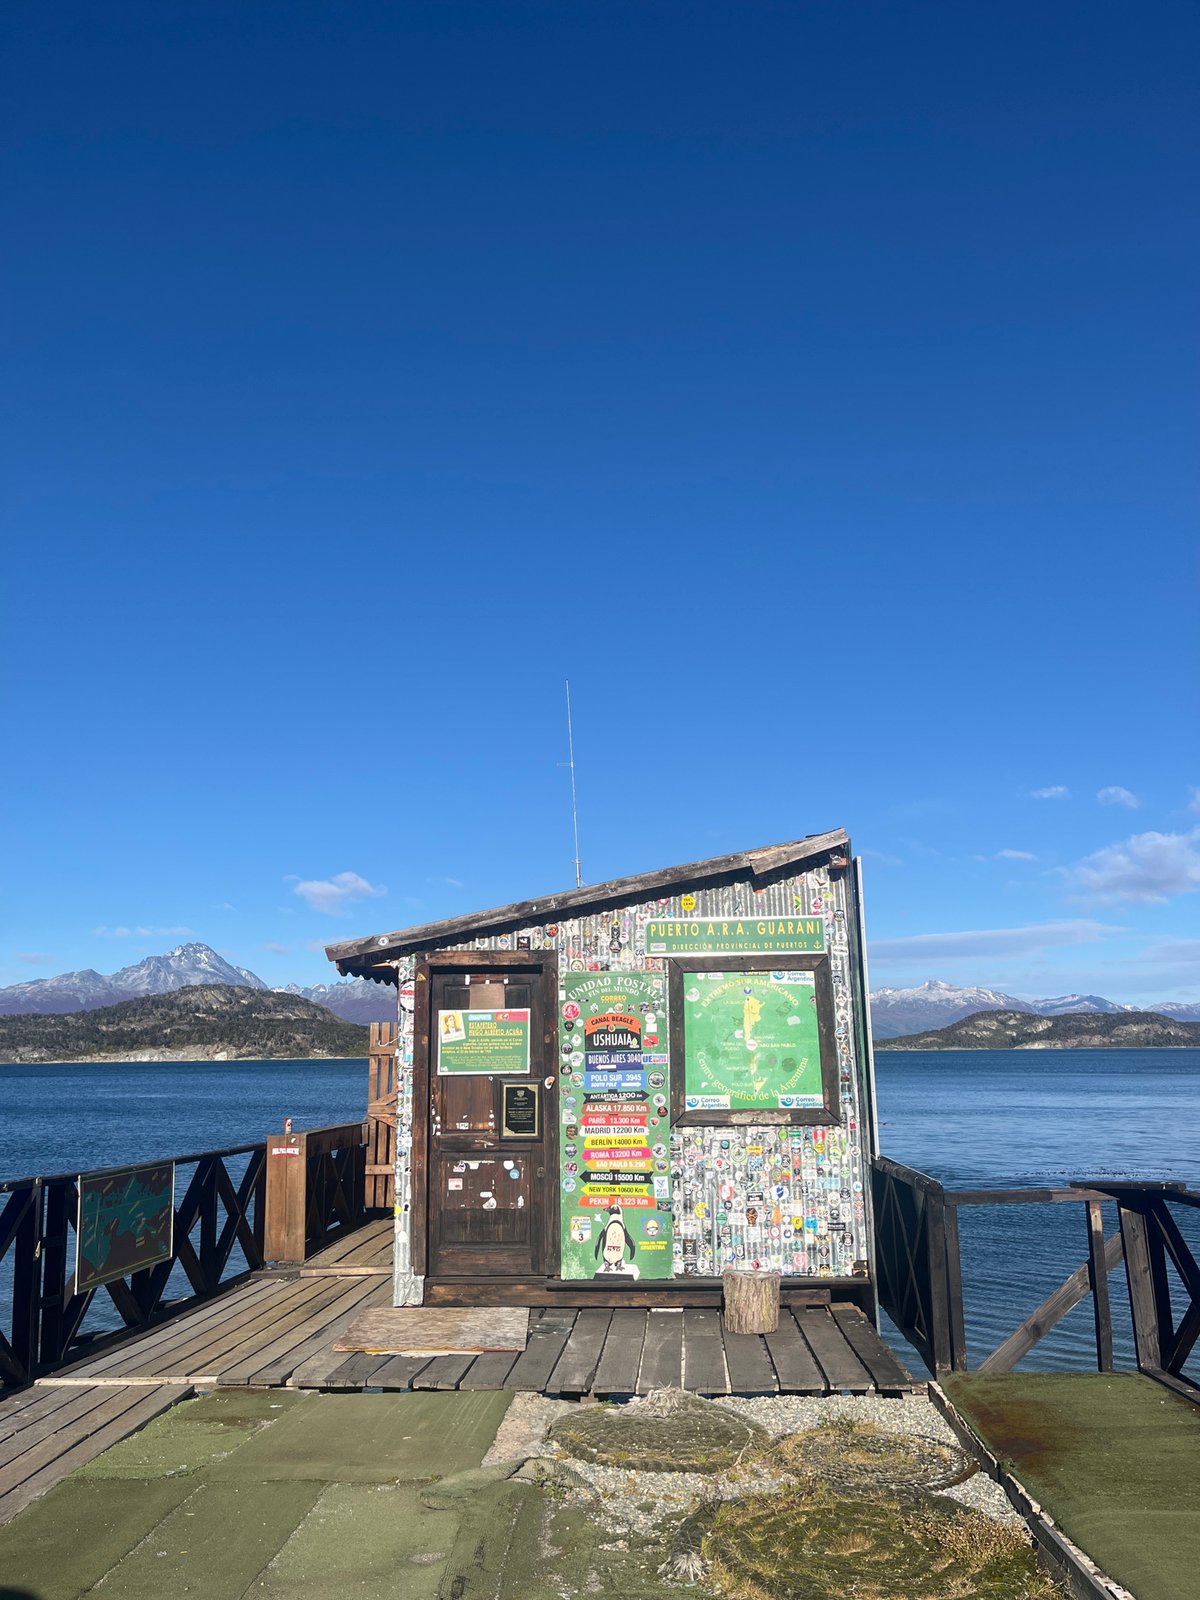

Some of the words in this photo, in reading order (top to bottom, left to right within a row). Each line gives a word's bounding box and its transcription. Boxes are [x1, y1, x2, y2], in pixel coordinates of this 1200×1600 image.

[650, 923, 699, 937] PUERTO
[706, 922, 750, 936] A.R.A.
[757, 920, 820, 935] GUARANI
[672, 942, 713, 951] DIRECCIÓN
[776, 941, 808, 949] PUERTOS
[568, 977, 612, 1000] UNIDAD
[617, 976, 658, 1000] POSTAL
[588, 989, 600, 998] FIN
[614, 986, 639, 997] MUNDO
[701, 981, 735, 1008] EXTREMO
[591, 1016, 609, 1026] CANAL
[612, 1015, 634, 1025] BEAGLE
[593, 1033, 632, 1047] USHUAIA
[588, 1054, 609, 1064] BUENOS
[611, 1054, 626, 1063] AIRES
[591, 1074, 608, 1082] POLO
[586, 1104, 612, 1112] ALASKA
[613, 1104, 635, 1112] 17.850
[590, 1151, 610, 1159] ROMA
[611, 1150, 630, 1158] 13200
[590, 1172, 613, 1181] MOSCÚ
[578, 1233, 584, 1241] 3
